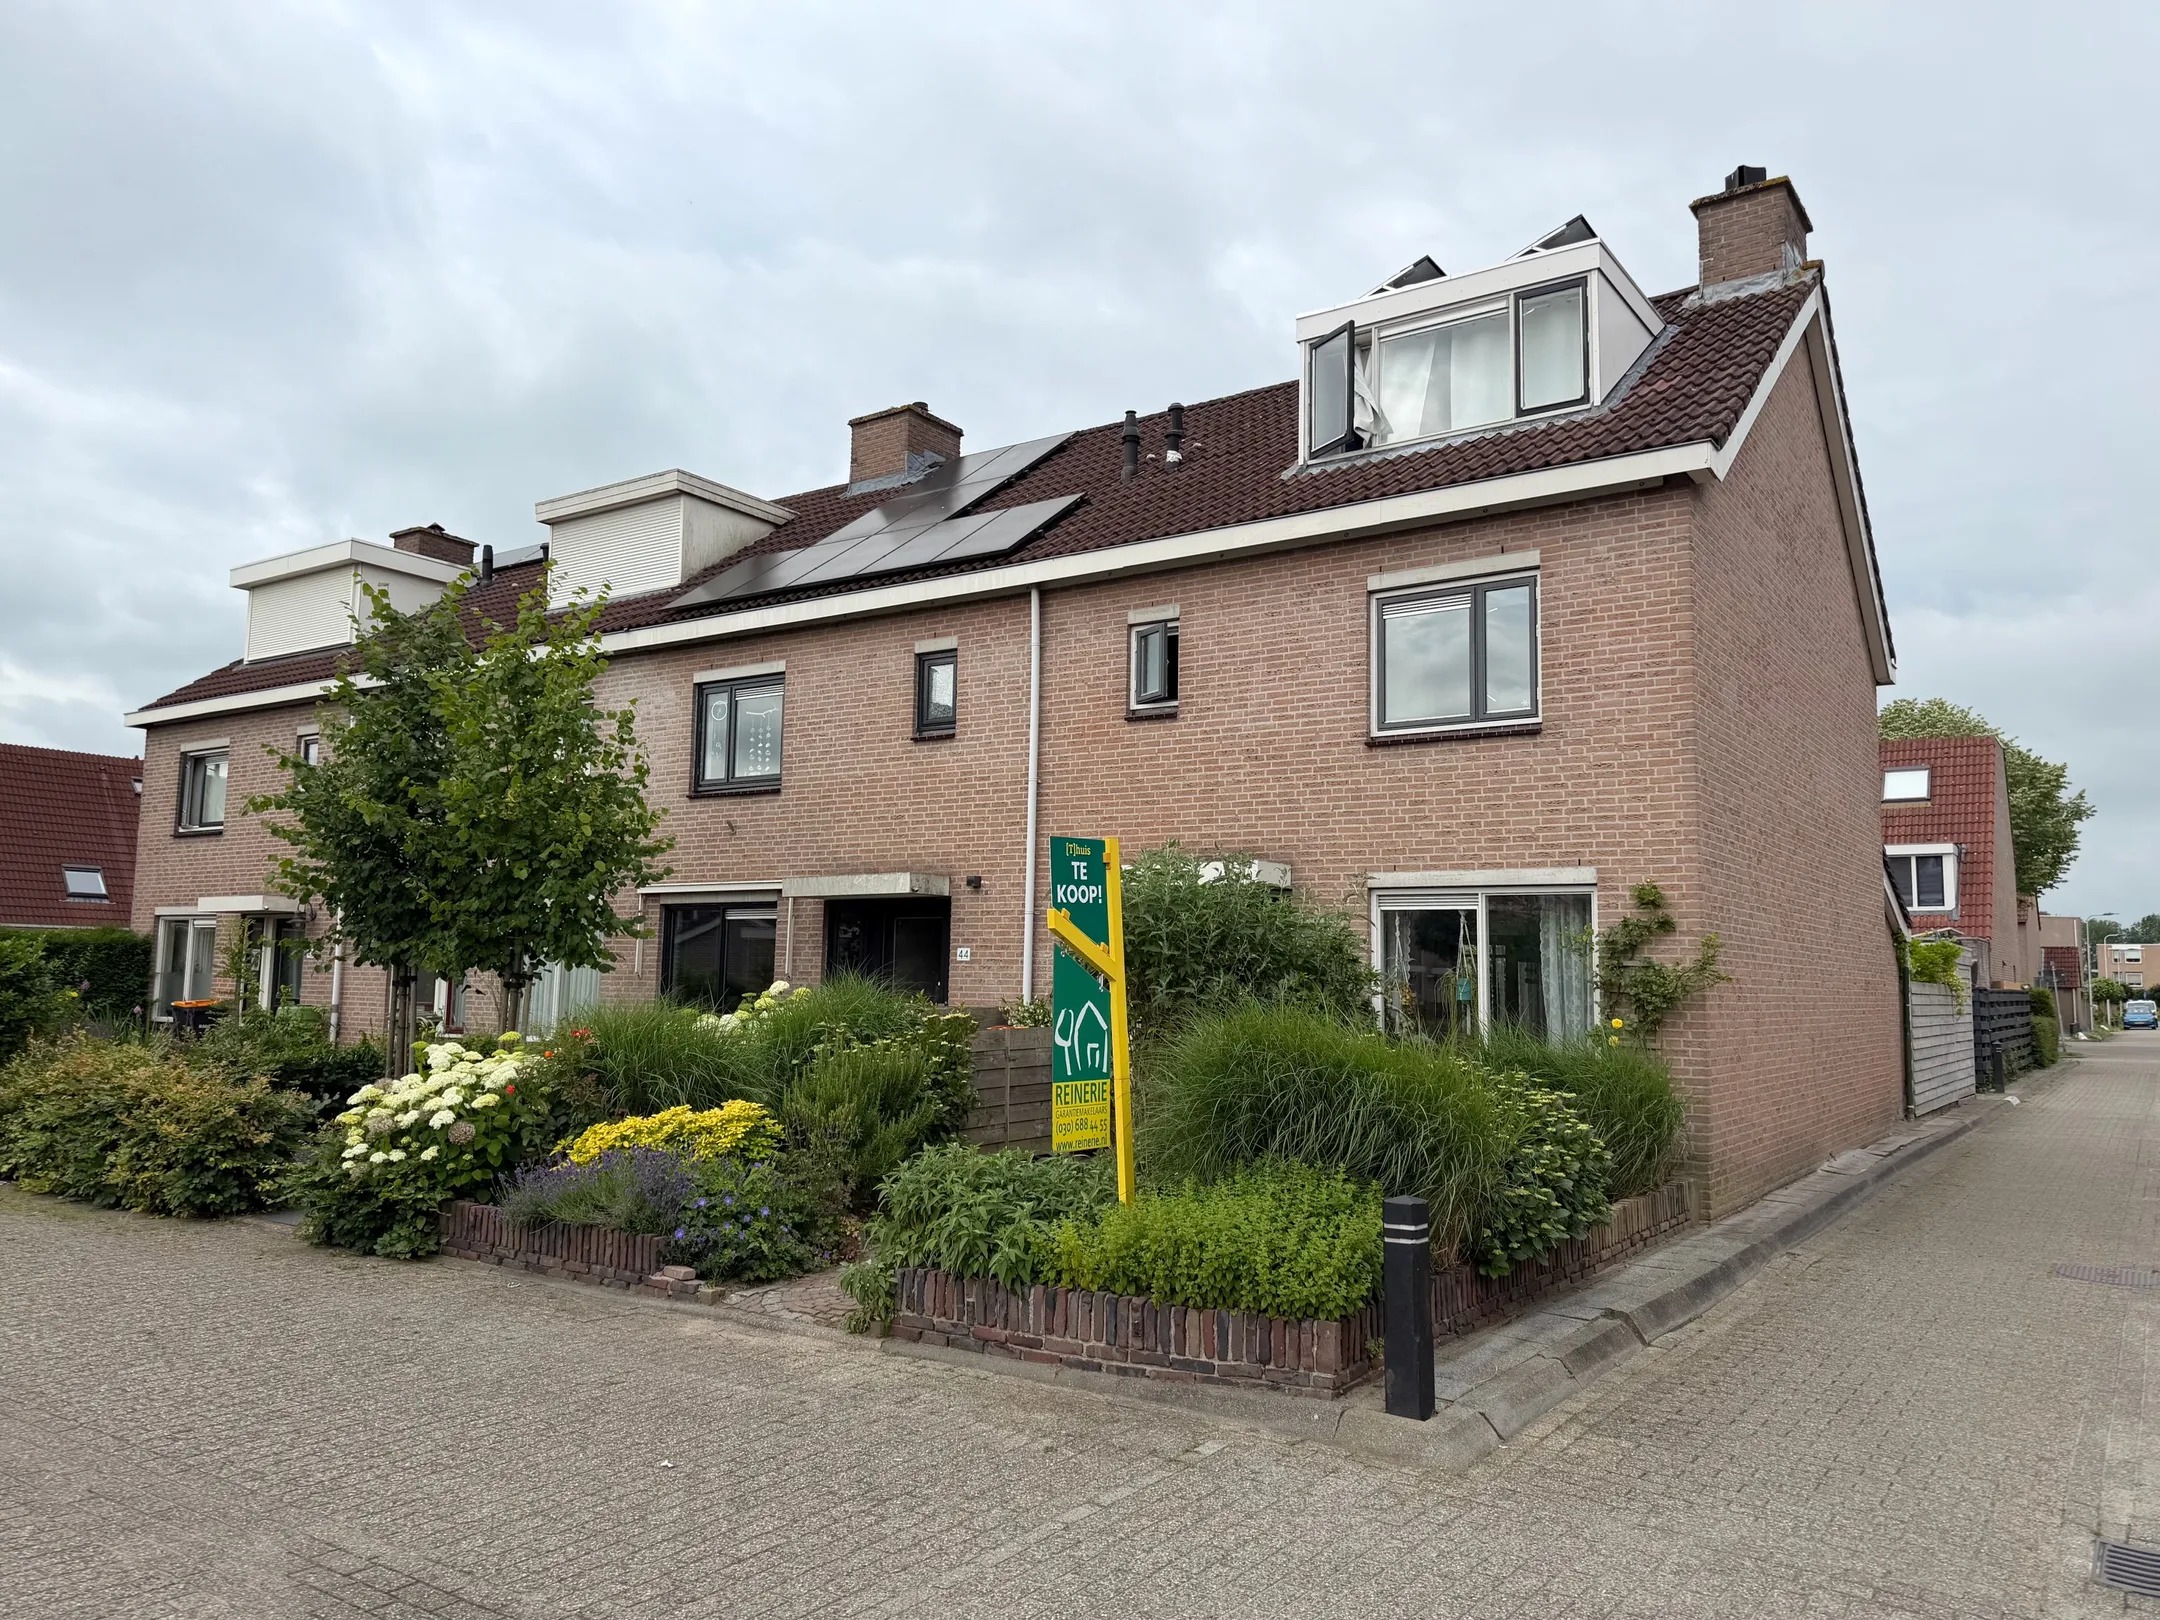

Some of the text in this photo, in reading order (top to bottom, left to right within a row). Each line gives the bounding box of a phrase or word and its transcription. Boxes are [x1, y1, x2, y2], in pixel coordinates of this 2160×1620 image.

[1071, 861, 1088, 880] TE
[1057, 884, 1102, 904] KOOP!
[959, 949, 968, 959] 44
[1055, 1081, 1107, 1106] REINERIE
[1055, 1117, 1107, 1136] (030) 688 44 55
[1056, 1133, 1107, 1152] www.reinerie.nl
